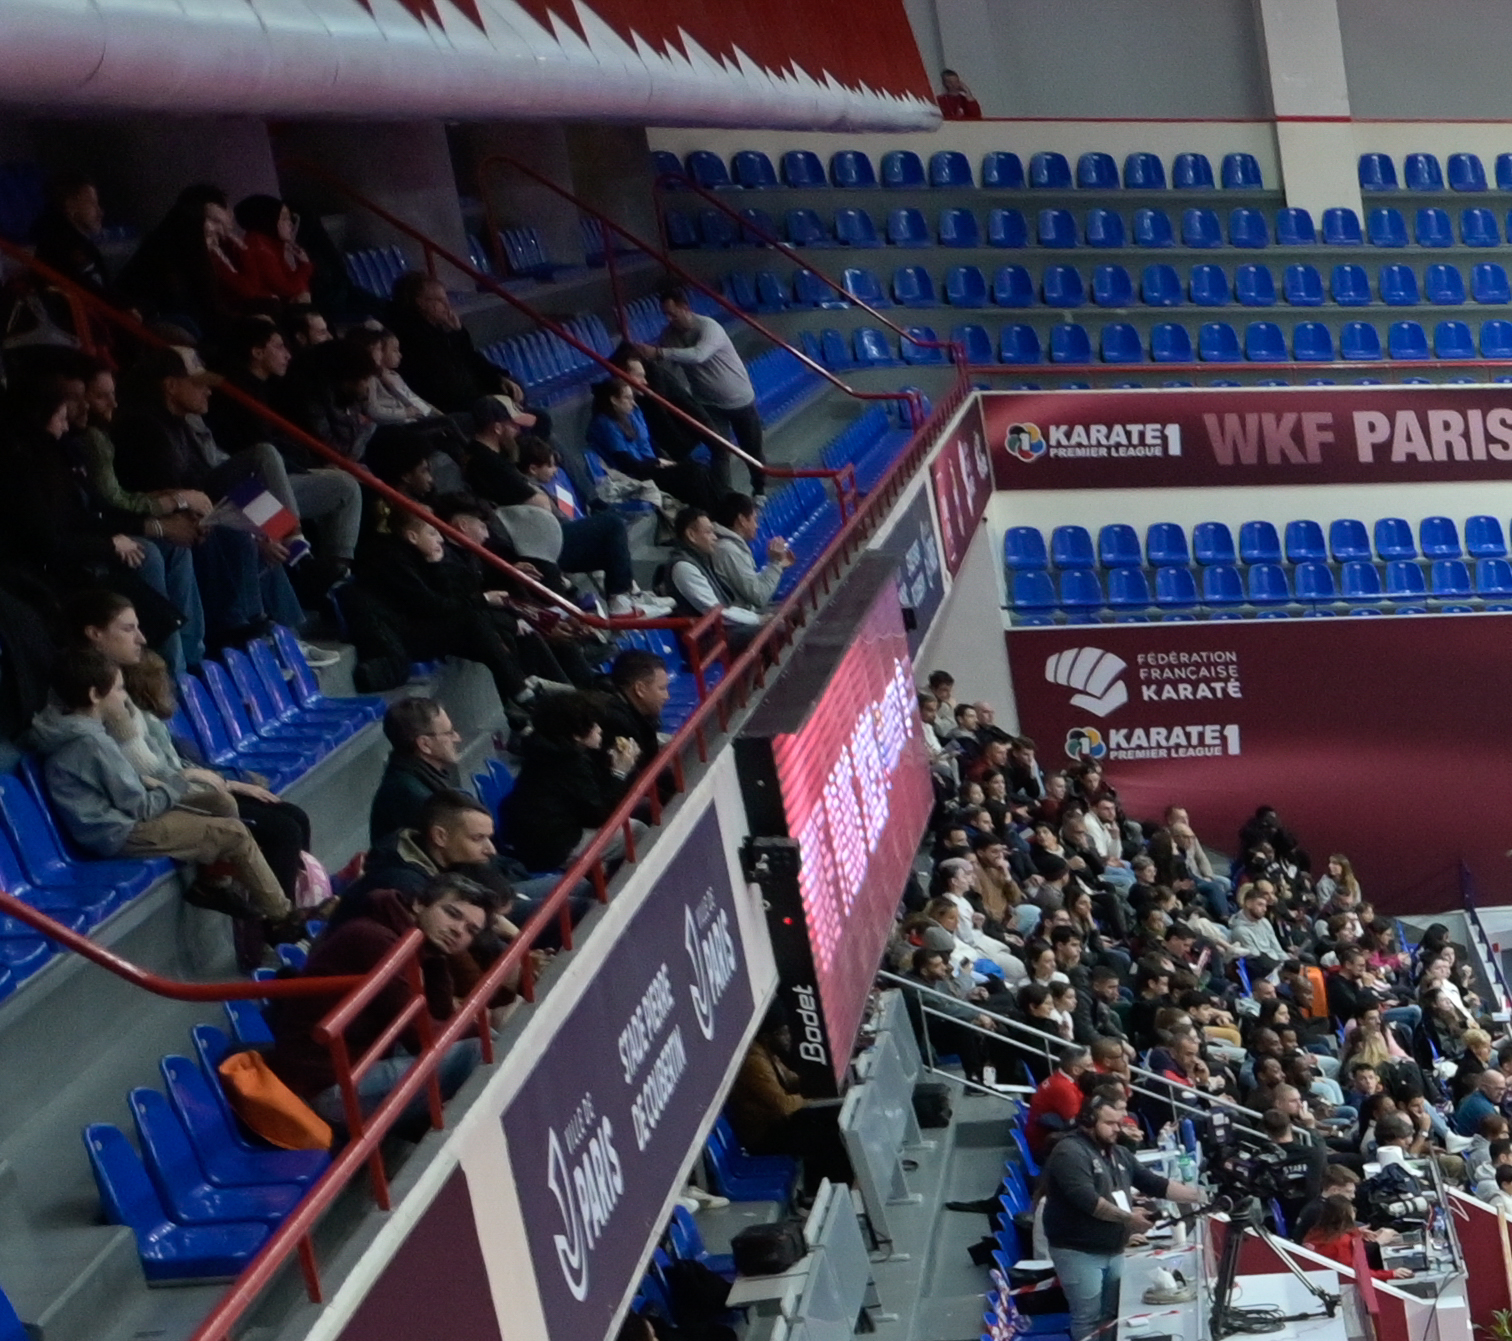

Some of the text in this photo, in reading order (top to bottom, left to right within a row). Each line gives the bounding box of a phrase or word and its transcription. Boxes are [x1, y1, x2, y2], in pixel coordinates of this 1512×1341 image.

[1050, 447, 1162, 458] PREMIER LEAGUE
[1204, 412, 1335, 466] WKF
[1137, 650, 1237, 666] FÉDÉRATION
[1139, 664, 1238, 680] FRANÇAISE
[1141, 679, 1242, 701] KARATÉ
[1109, 747, 1222, 760] PREMIER LEAGUE
[822, 743, 870, 923] PARIS
[700, 902, 738, 1009] PARIS
[615, 956, 676, 1091] STADE PIERRE
[792, 984, 828, 1066] Bodet
[629, 1020, 688, 1156] DE COUBERTIN
[563, 1102, 587, 1162] VILLE
[571, 1106, 626, 1256] PARIS
